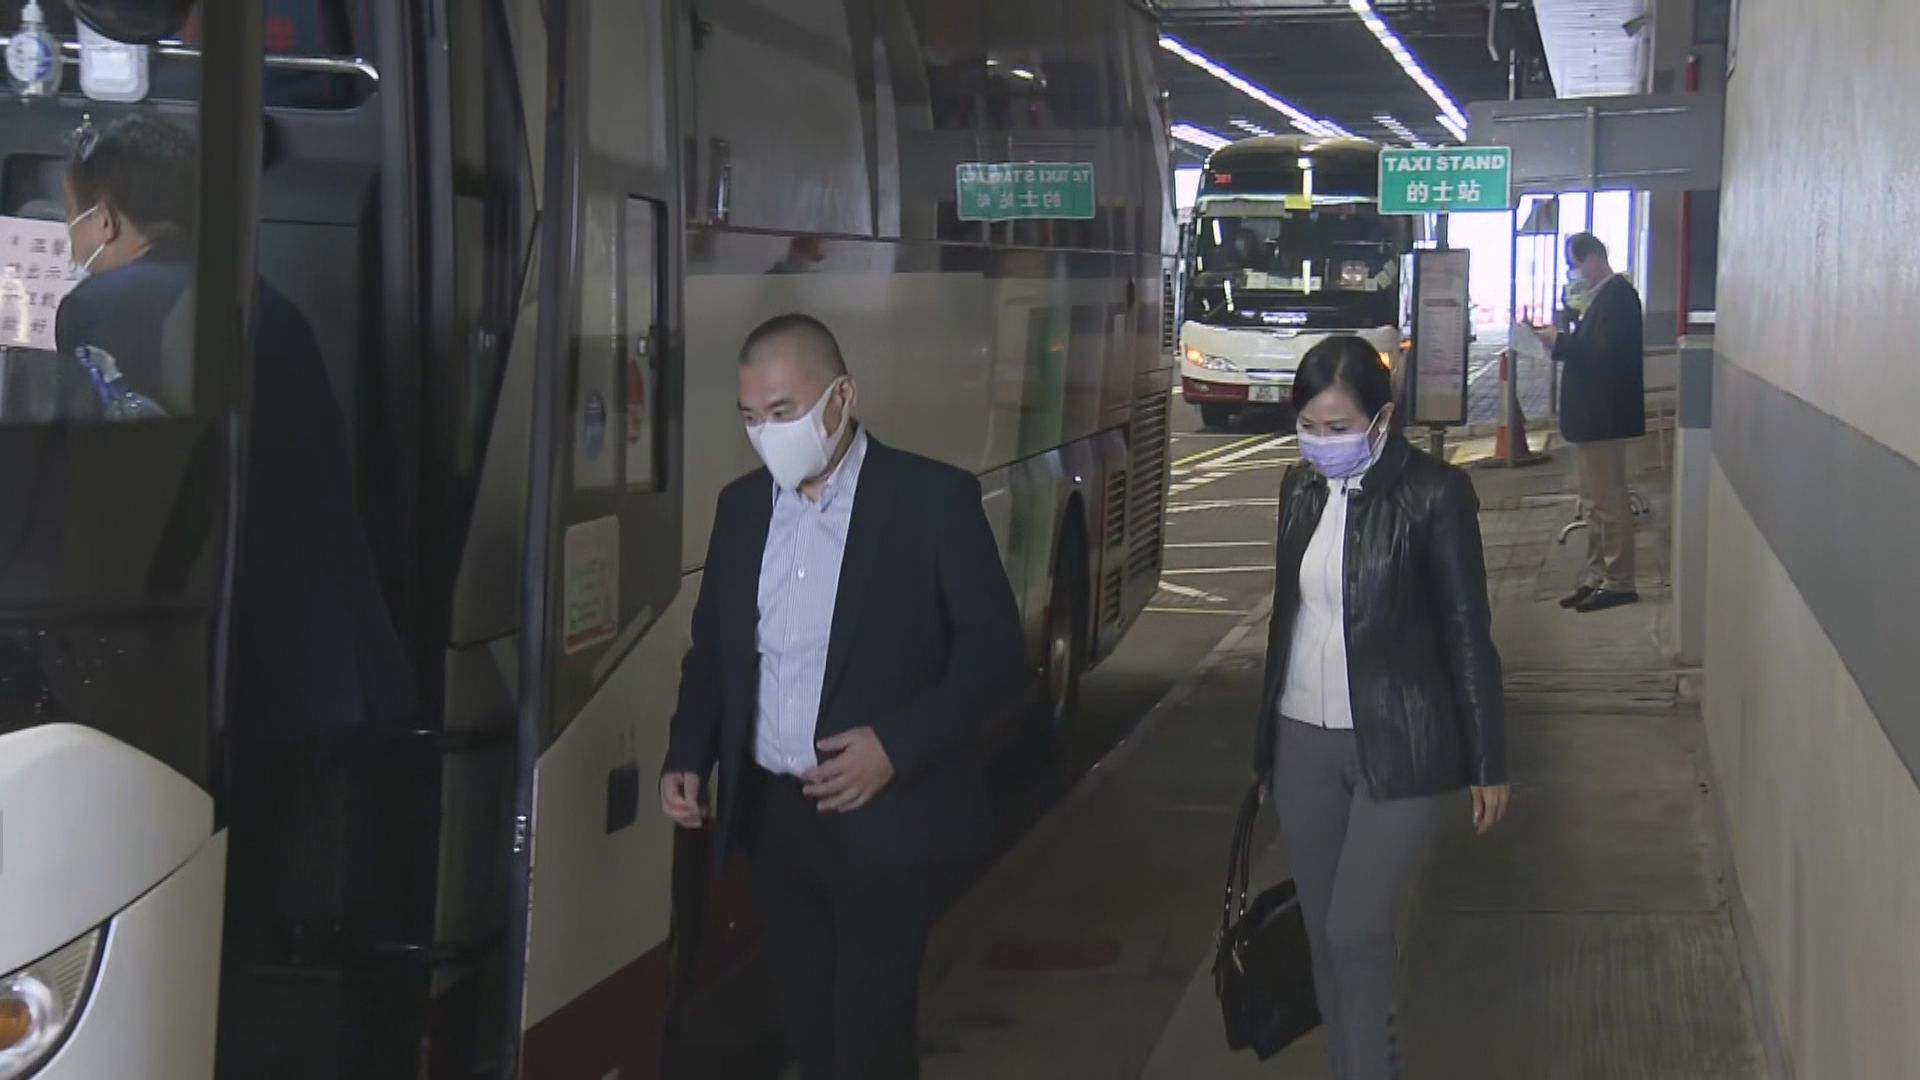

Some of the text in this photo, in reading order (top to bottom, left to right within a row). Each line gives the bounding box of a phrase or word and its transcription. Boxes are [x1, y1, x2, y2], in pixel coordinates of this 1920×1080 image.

[1384, 155, 1506, 172] TAXI STAND
[1406, 179, 1481, 203] 的士站
